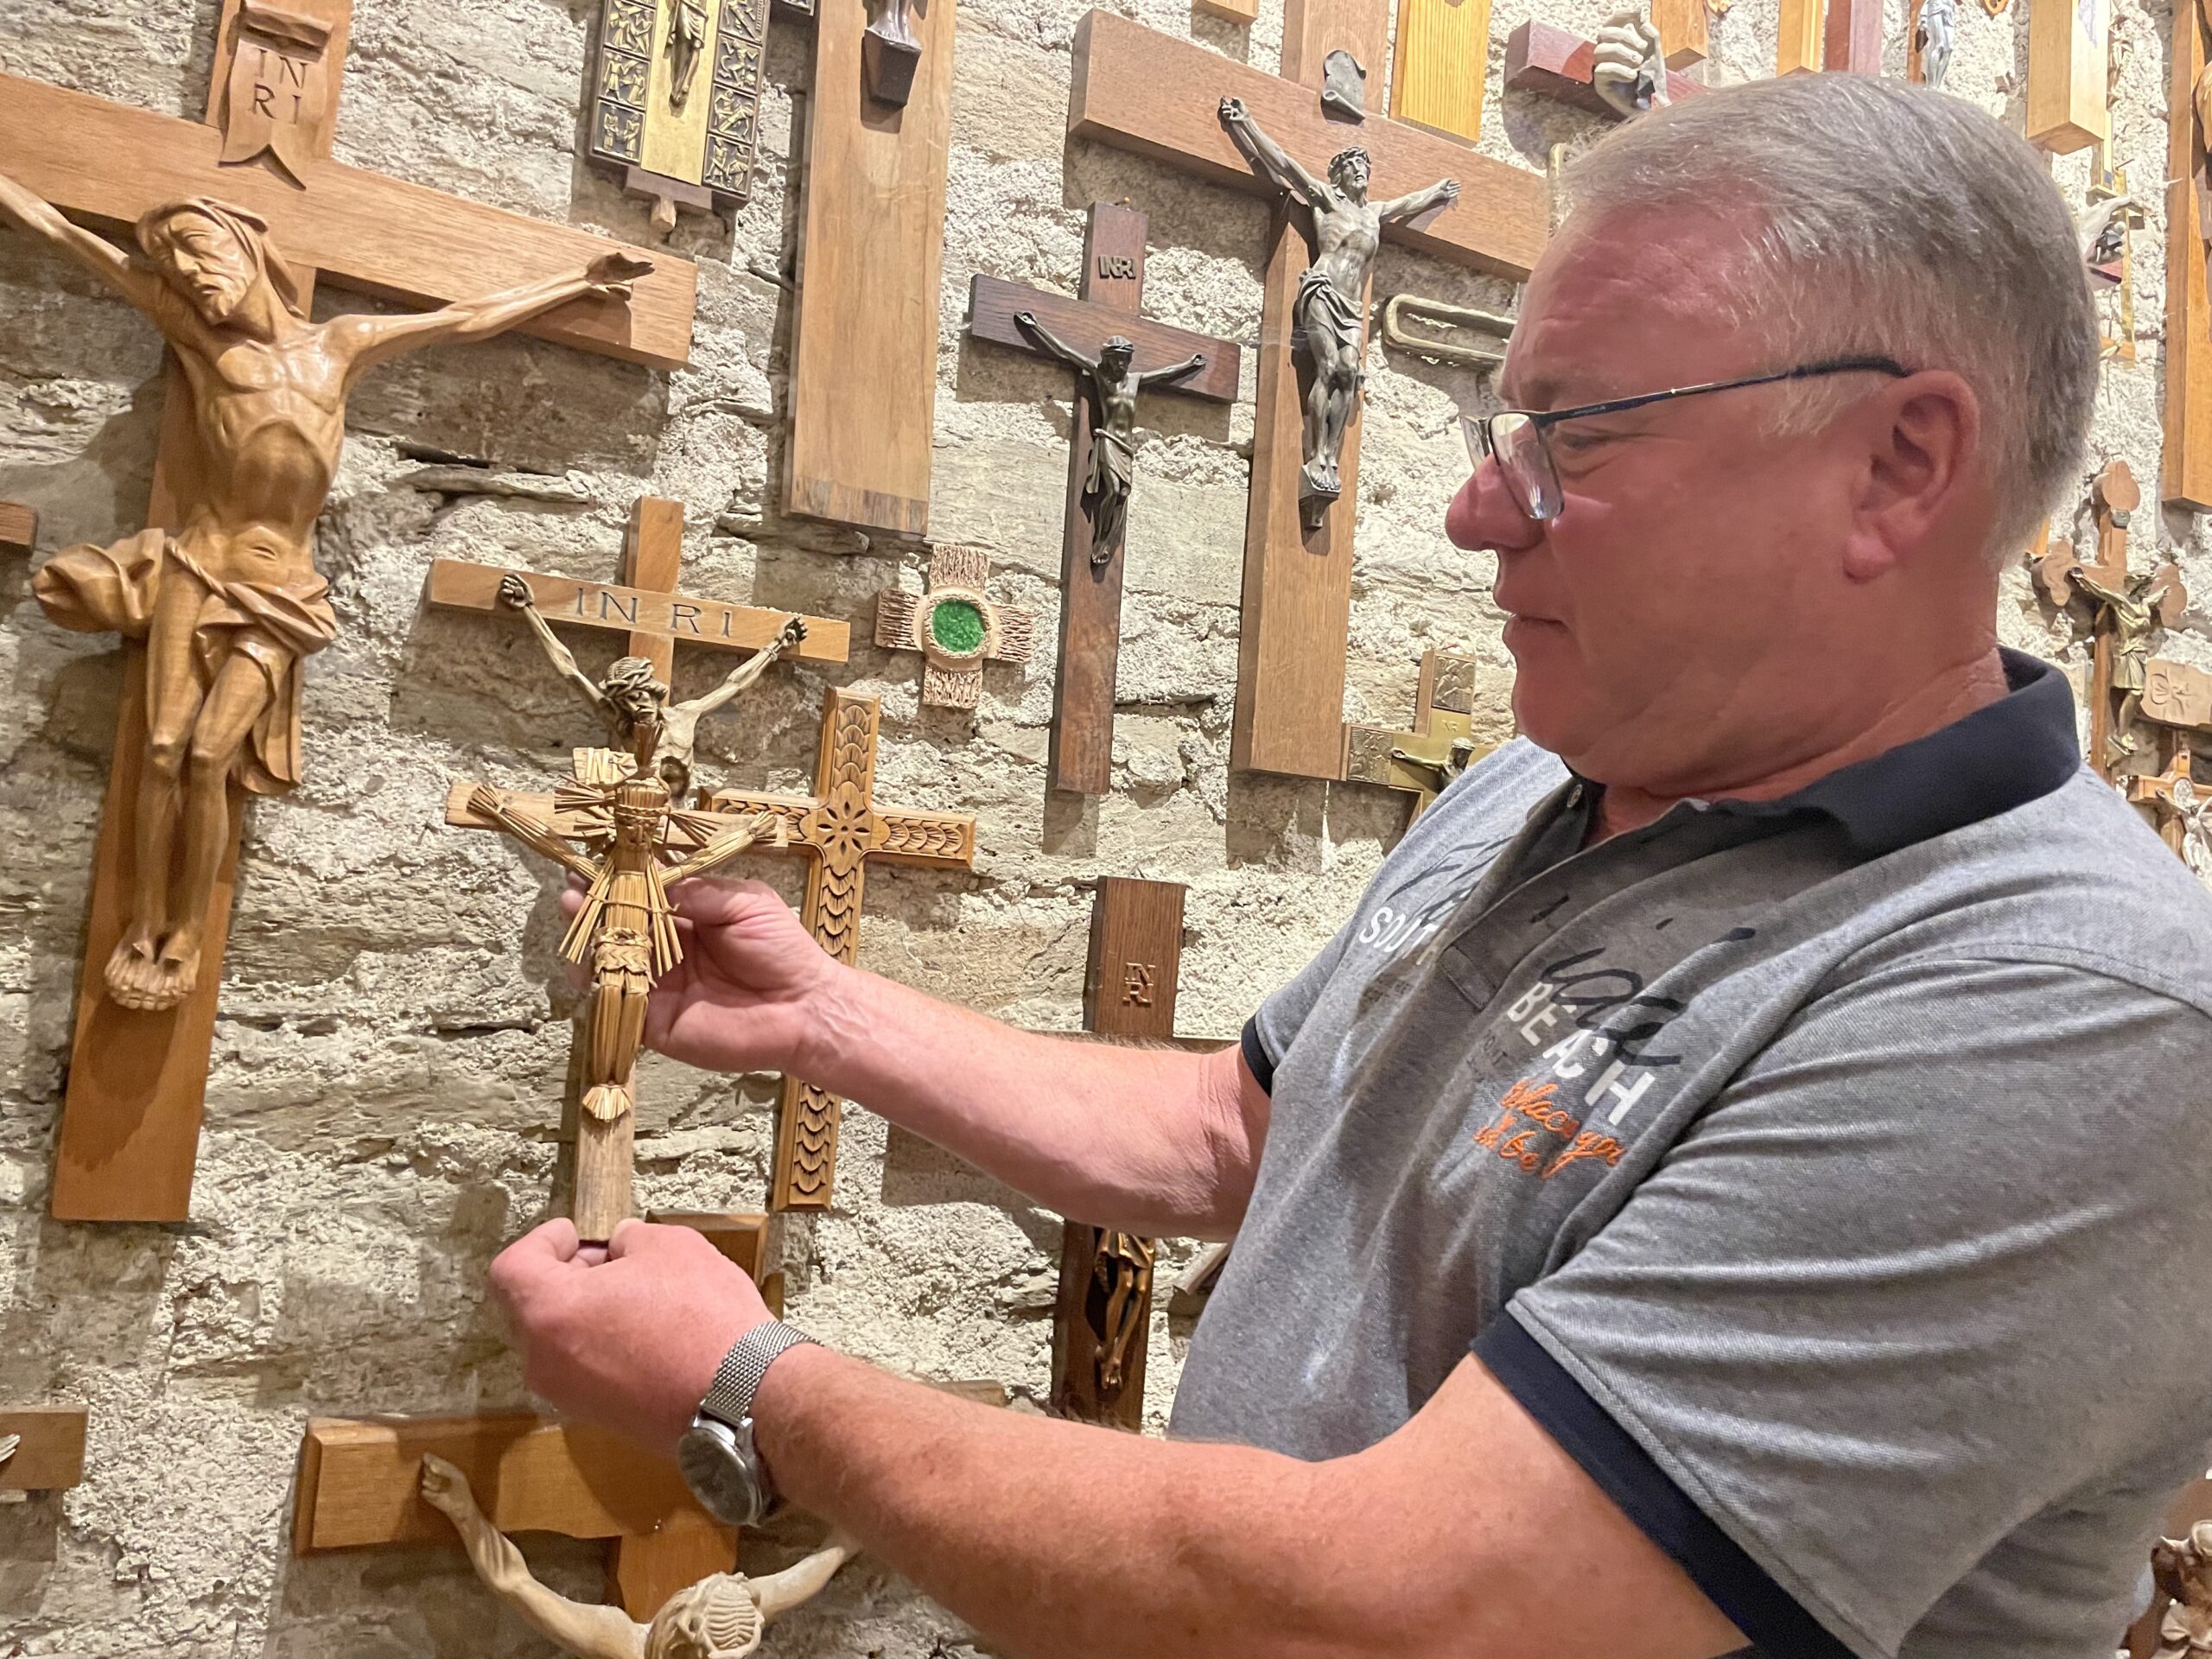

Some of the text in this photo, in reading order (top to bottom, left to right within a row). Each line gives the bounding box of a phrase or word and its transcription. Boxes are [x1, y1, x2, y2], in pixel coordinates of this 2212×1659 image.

[255, 48, 308, 90] IN
[248, 82, 302, 126] RI
[1507, 981, 1656, 1127] BEACH
